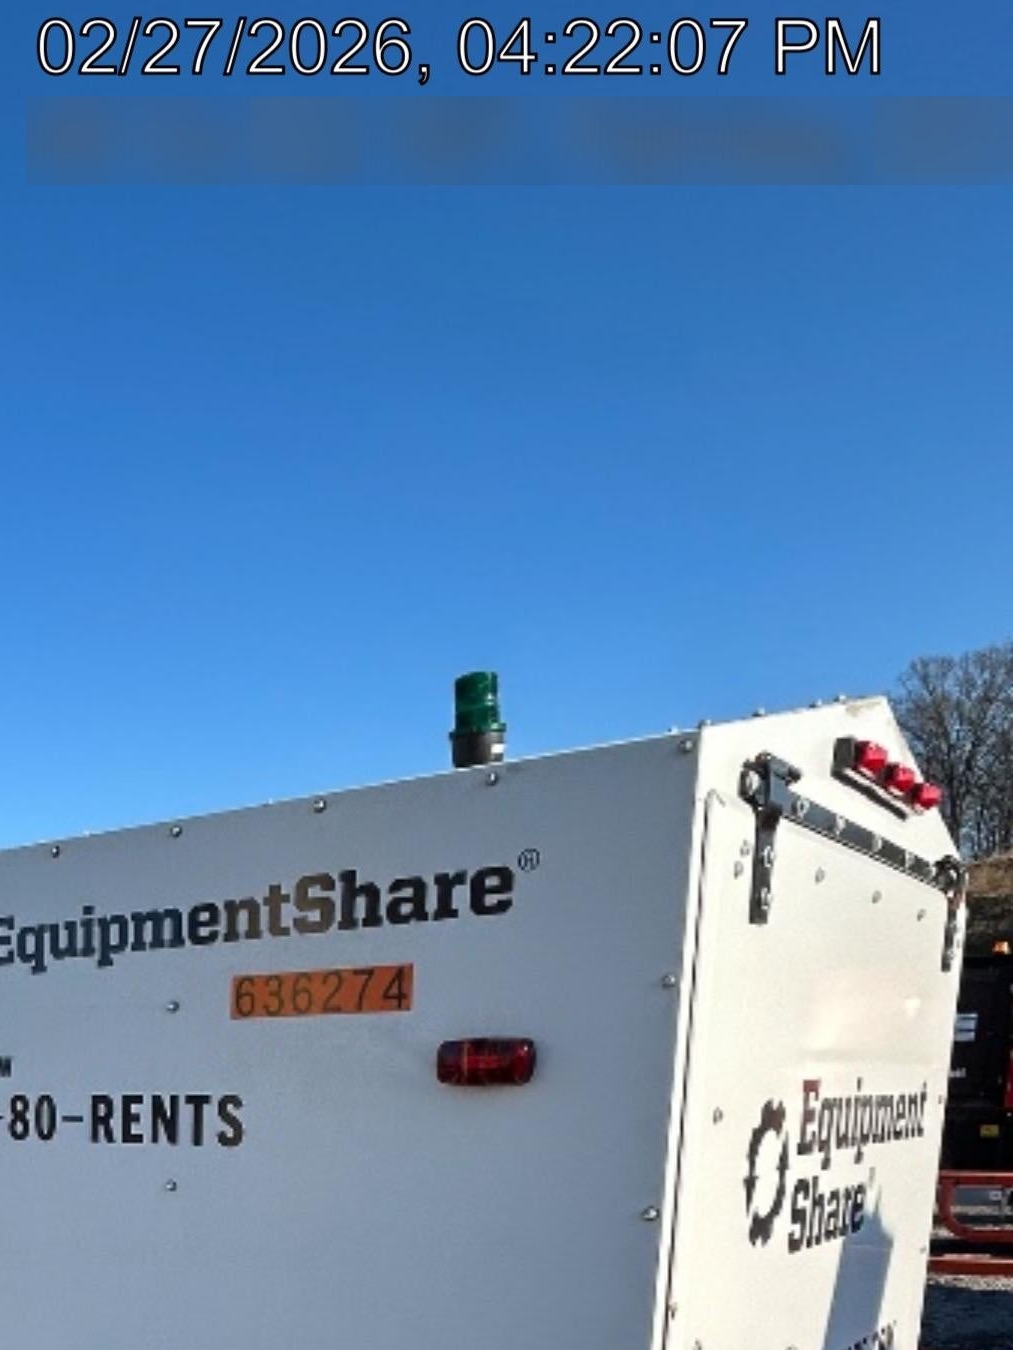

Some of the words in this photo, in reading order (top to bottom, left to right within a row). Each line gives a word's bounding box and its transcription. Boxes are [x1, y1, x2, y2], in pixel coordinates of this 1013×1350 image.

[235, 968, 408, 1016] 636274
[795, 1077, 928, 1171] Equipment
[787, 1173, 866, 1254] Share
